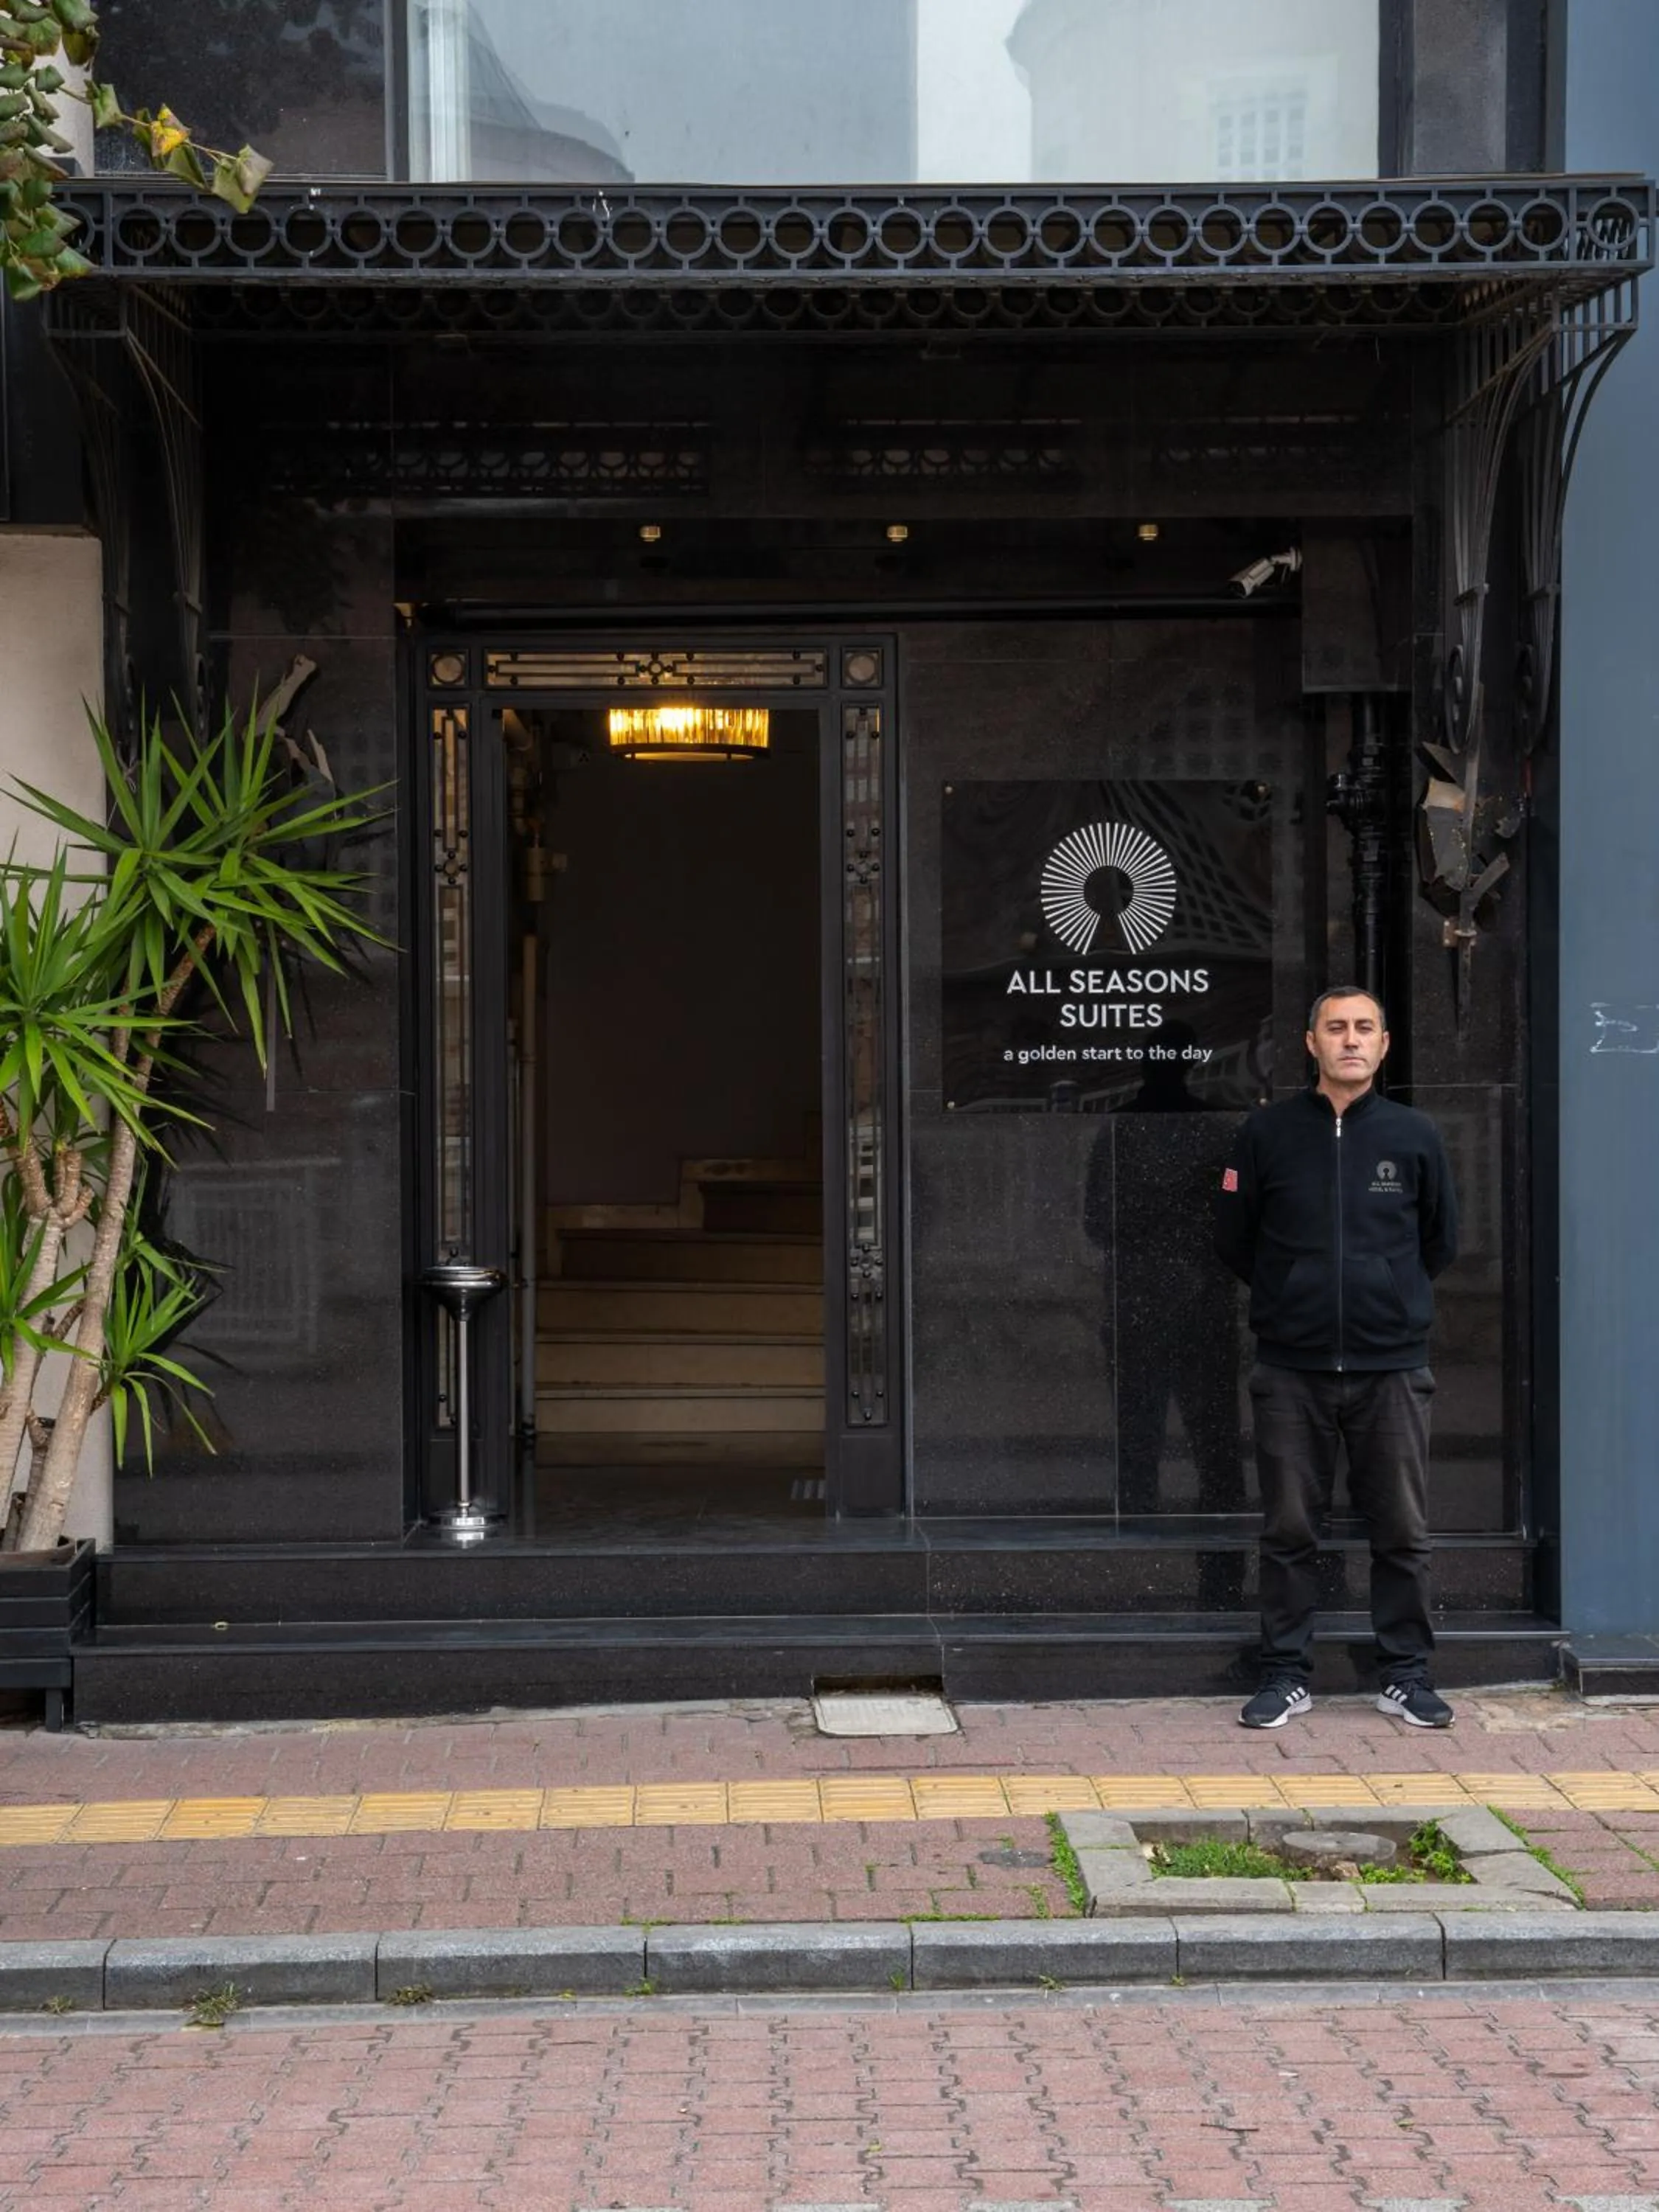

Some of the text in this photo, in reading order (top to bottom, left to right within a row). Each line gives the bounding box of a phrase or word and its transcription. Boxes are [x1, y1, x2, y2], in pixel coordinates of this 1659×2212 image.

[1006, 969, 1209, 994] ALL SEASONS
[1060, 1004, 1163, 1028] SUITES
[1004, 1044, 1213, 1065] a golden start to the day
